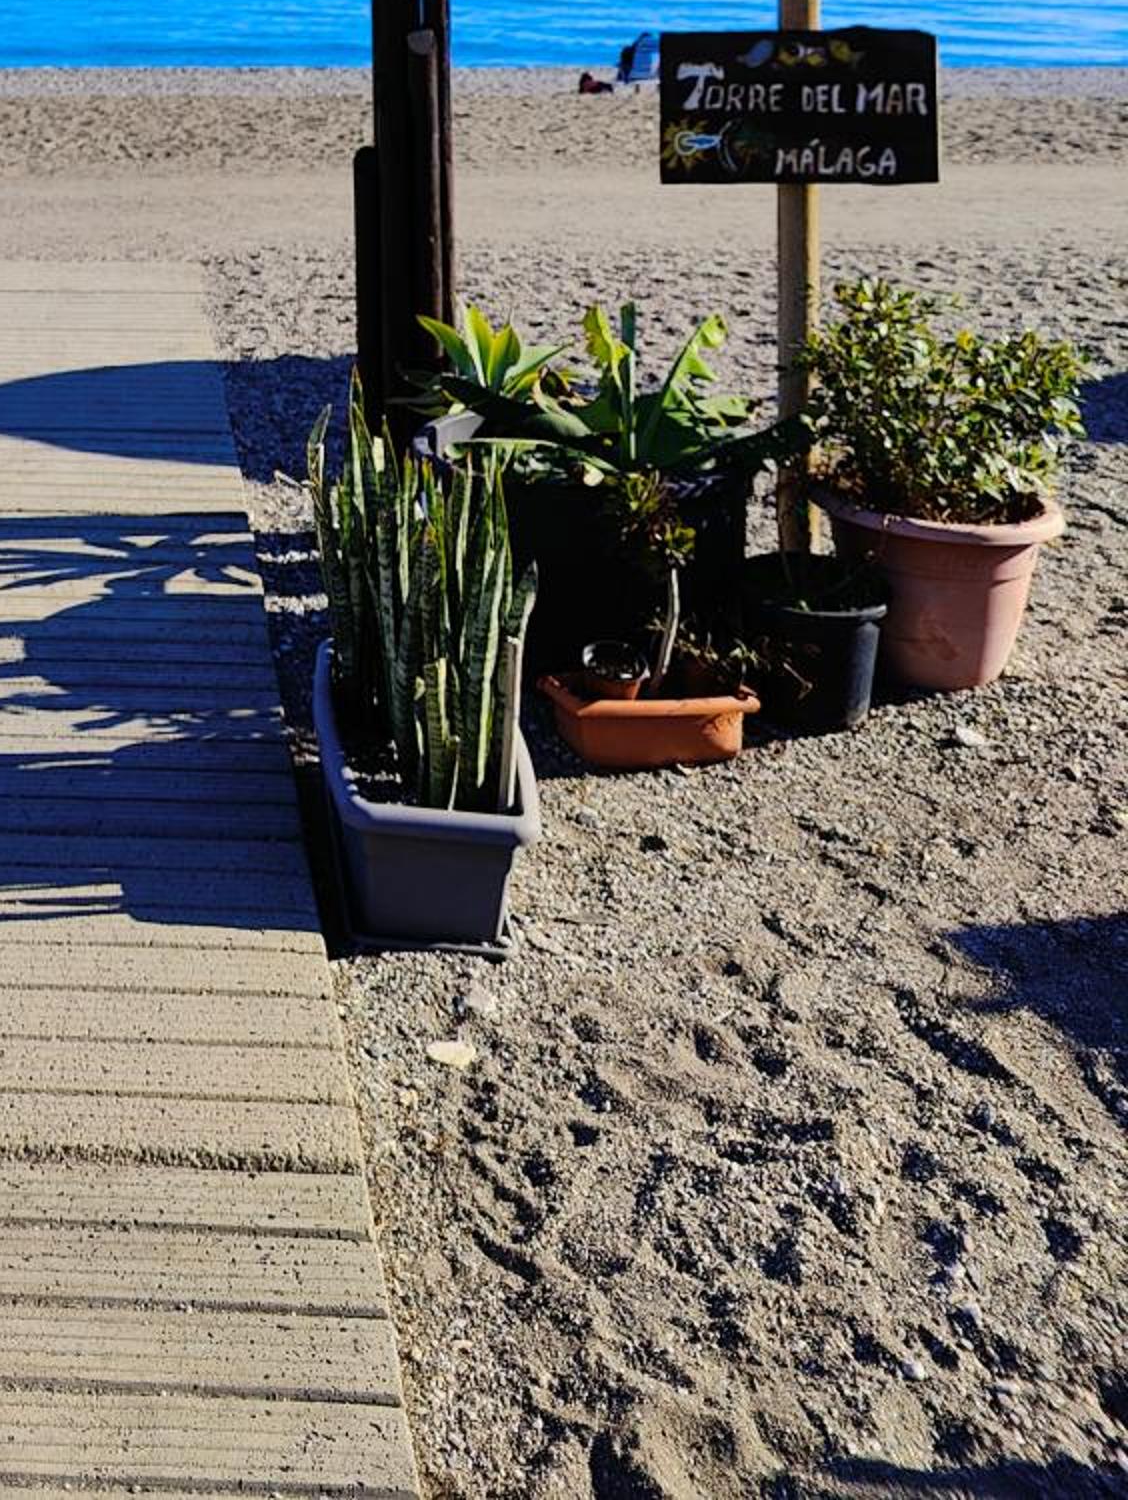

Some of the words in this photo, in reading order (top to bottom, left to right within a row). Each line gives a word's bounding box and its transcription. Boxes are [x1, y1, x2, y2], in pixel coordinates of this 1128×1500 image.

[677, 62, 784, 111] TORRE
[801, 82, 846, 113] DEL
[856, 81, 928, 115] MAR
[775, 139, 897, 177] MÁLAGA
